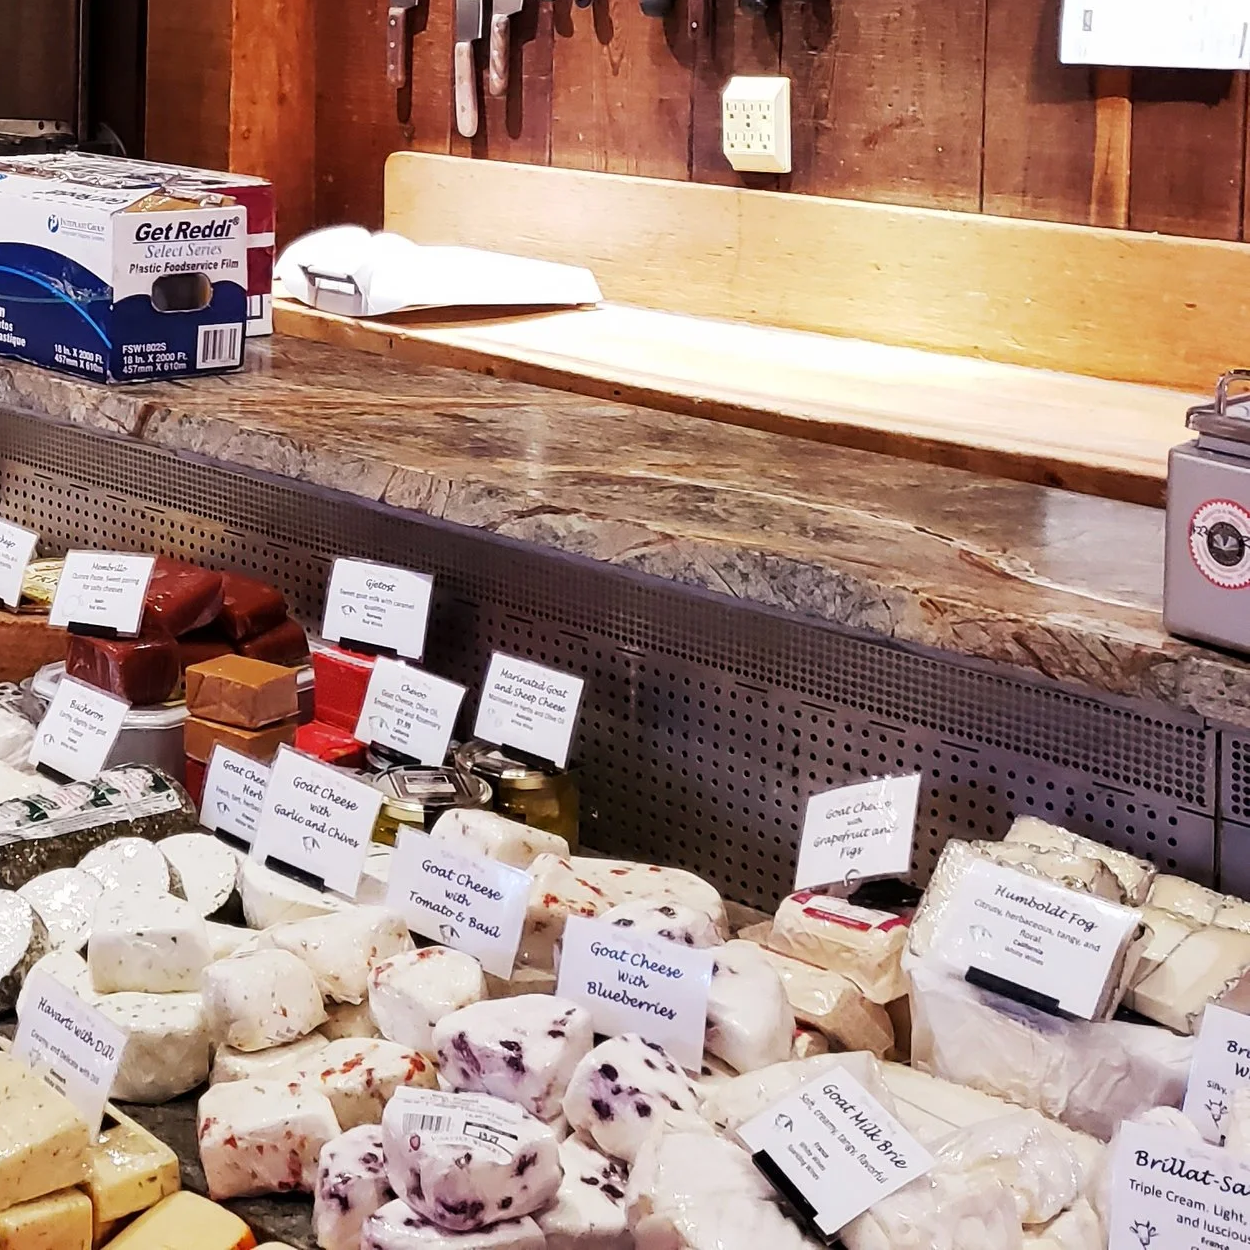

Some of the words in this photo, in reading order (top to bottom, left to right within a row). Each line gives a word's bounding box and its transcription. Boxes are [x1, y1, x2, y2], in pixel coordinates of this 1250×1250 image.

[135, 222, 174, 242] Get
[144, 245, 183, 259] Select
[185, 242, 222, 257] Series
[129, 263, 162, 274] Plastic
[164, 260, 218, 273] Foodservice
[221, 259, 239, 270] Film
[54, 344, 62, 354] 18
[72, 348, 78, 358] X
[78, 349, 94, 362] 2000
[54, 353, 78, 368] 457mm
[79, 360, 85, 369] X
[123, 355, 132, 365] 18
[147, 354, 154, 363] X
[155, 353, 176, 362] 2000
[122, 364, 154, 374] 457mm
[155, 363, 162, 372] X
[365, 578, 397, 592] Gjetost
[500, 668, 546, 691] Marinated
[546, 685, 569, 699] Goat
[494, 683, 512, 695] and
[513, 687, 537, 704] Sheep
[537, 696, 567, 713] Cheese
[223, 759, 246, 776] Goat
[244, 770, 267, 788] Chee
[242, 784, 264, 801] Herb
[292, 776, 321, 796] Goat
[320, 788, 359, 811] Cheese
[310, 803, 332, 818] with
[825, 806, 852, 820] Goat
[274, 803, 305, 824] Garlic
[304, 817, 327, 834] and
[327, 827, 360, 849] Chives
[813, 828, 871, 848] Grapefruit
[840, 845, 864, 859] Figs
[422, 859, 456, 882] Goat
[456, 873, 504, 901] Cheese
[445, 889, 472, 907] with
[409, 890, 456, 918] Tomato
[455, 911, 466, 923] &
[468, 916, 502, 938] Basil
[994, 884, 1070, 920] Humboldt
[1069, 911, 1099, 934] Fog
[1056, 929, 1082, 947] tangy,
[1083, 940, 1101, 953] and
[590, 941, 630, 963] Goat
[630, 953, 684, 979] Cheese
[617, 969, 649, 989] With
[587, 981, 678, 1021] Blueberries
[38, 996, 74, 1031] Havarti
[74, 1023, 96, 1047] with
[95, 1039, 116, 1061] Dill
[1235, 1061, 1250, 1078] W
[822, 1083, 857, 1115] Goat
[850, 1111, 882, 1143] Milk
[876, 1139, 908, 1170] Brie
[799, 1092, 816, 1111] Soft,
[813, 1108, 838, 1137] creamy,
[836, 1132, 858, 1157] tangy,
[856, 1152, 890, 1186] flavorful
[1134, 1149, 1250, 1197] Brillat-Sa
[1128, 1177, 1164, 1199] Triple
[1165, 1189, 1210, 1214] Cream.
[1212, 1202, 1249, 1227] Light,
[1175, 1212, 1201, 1230] and
